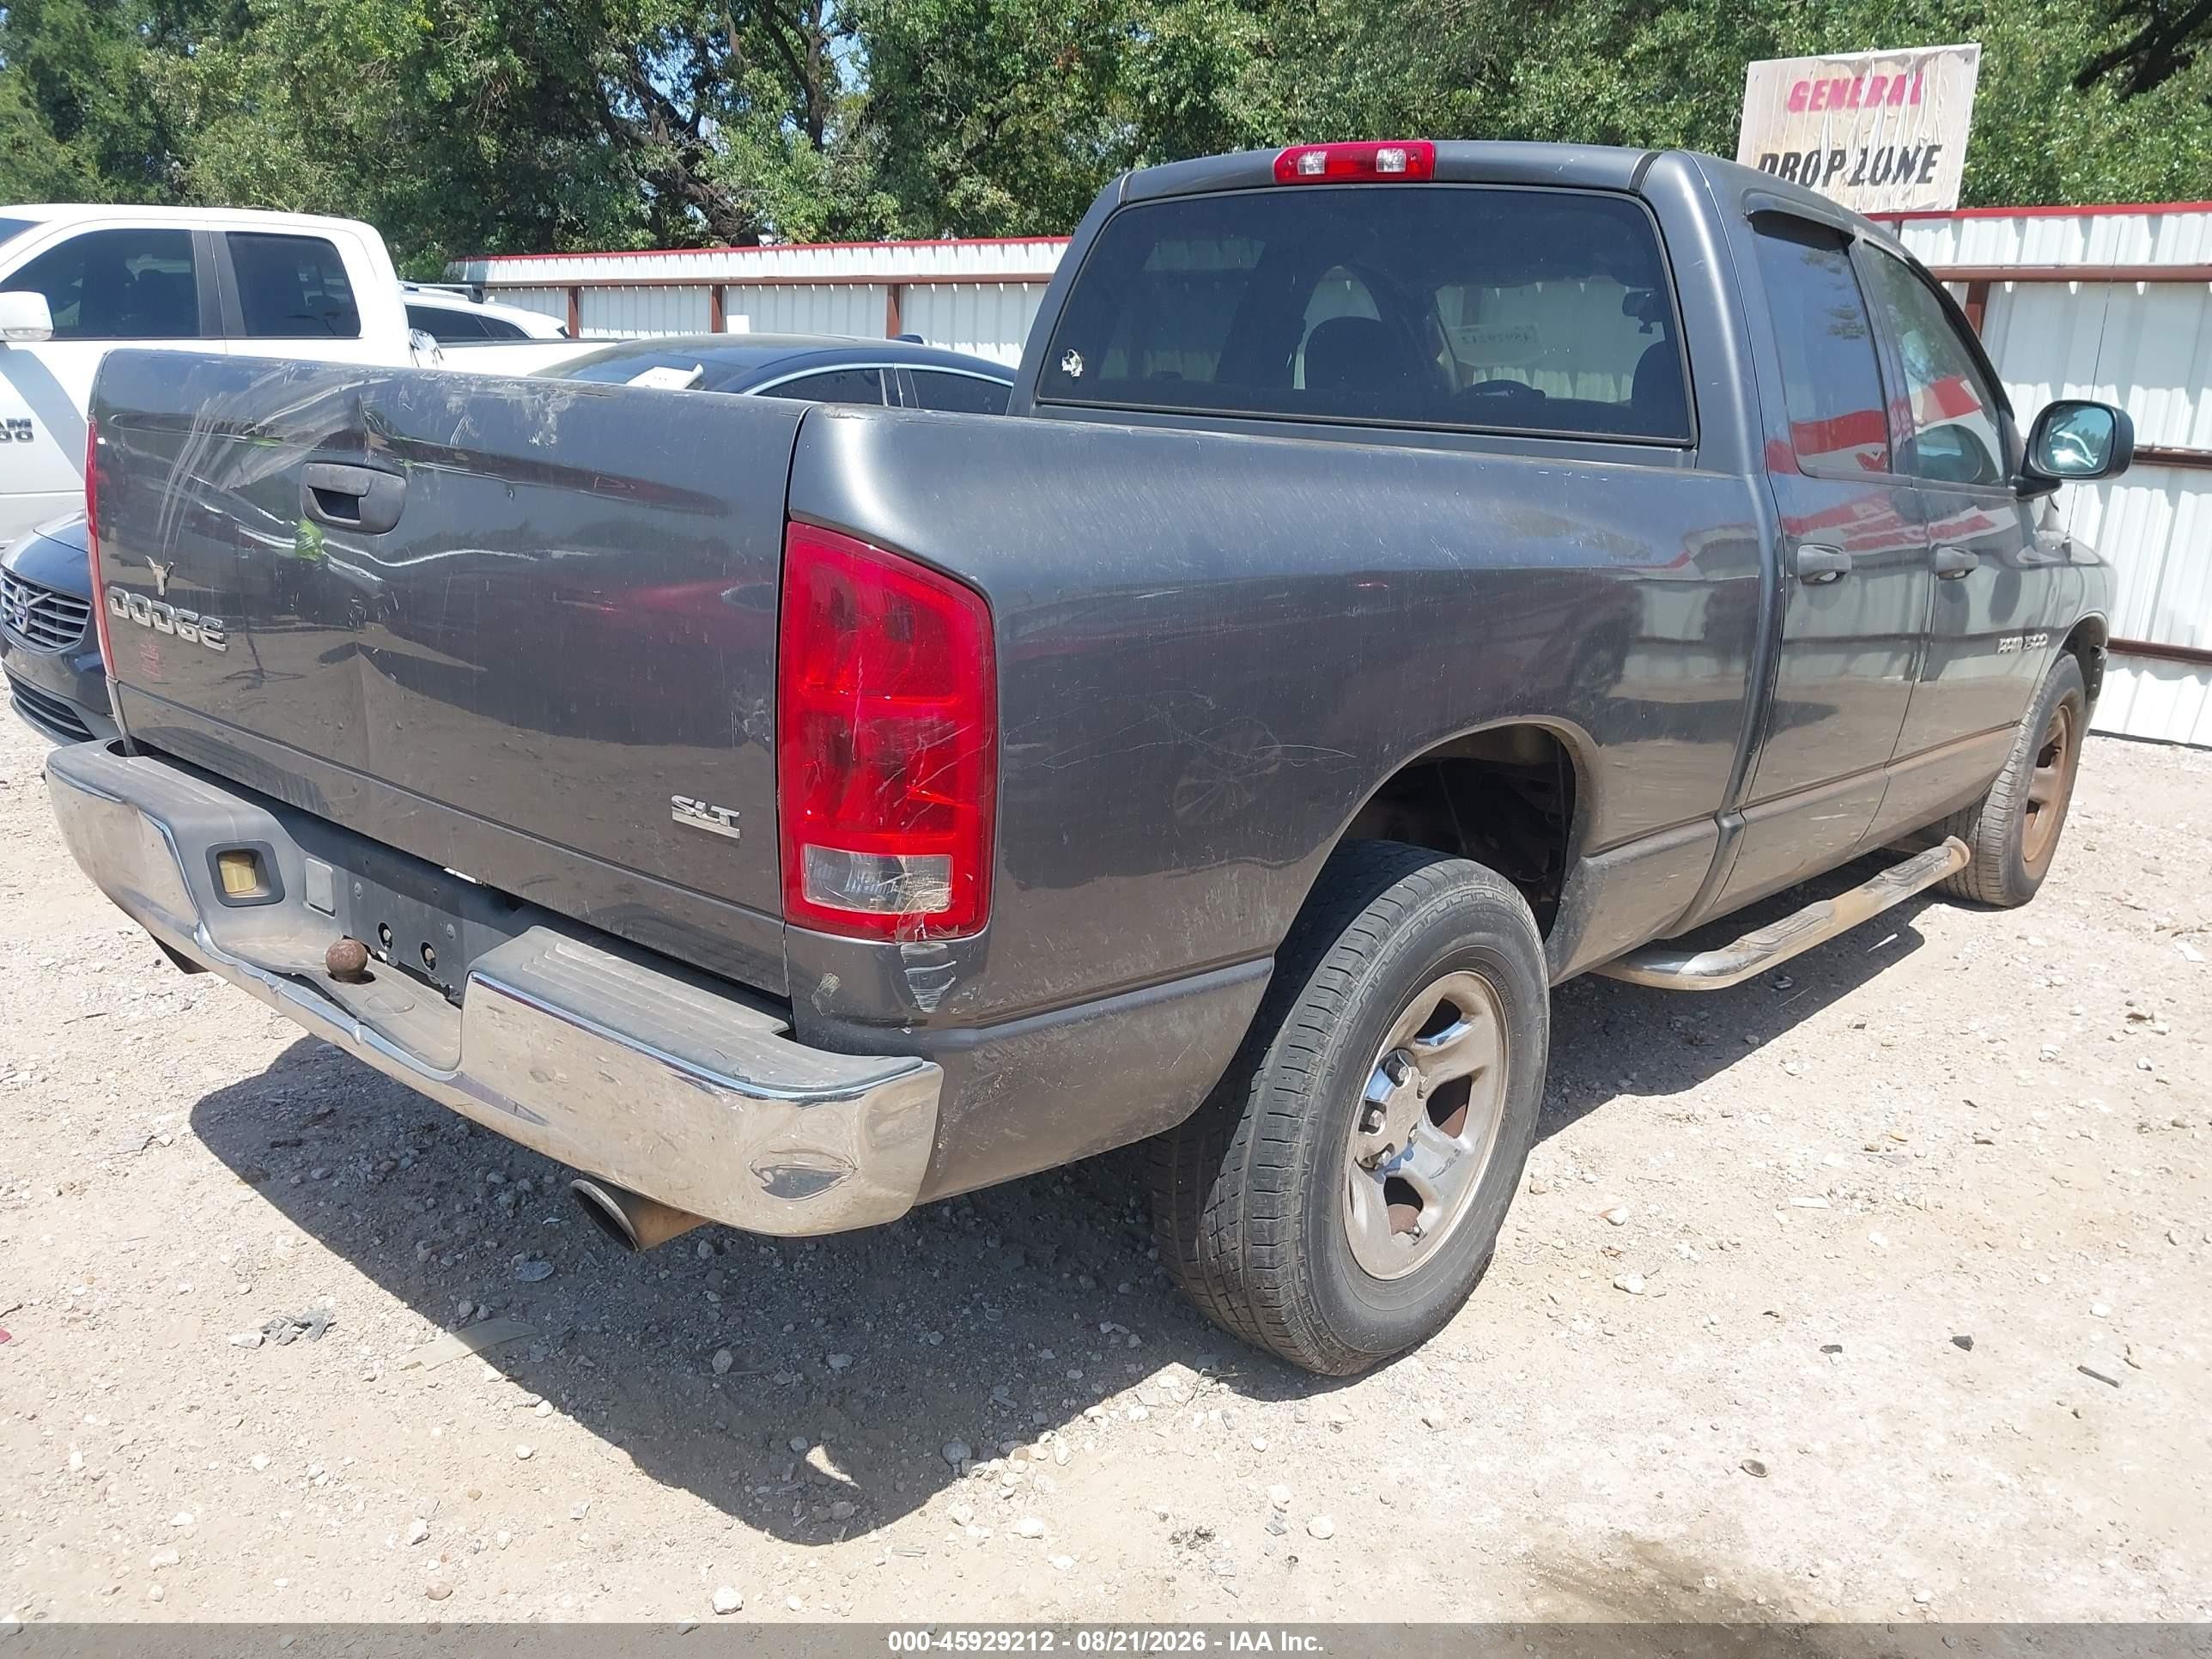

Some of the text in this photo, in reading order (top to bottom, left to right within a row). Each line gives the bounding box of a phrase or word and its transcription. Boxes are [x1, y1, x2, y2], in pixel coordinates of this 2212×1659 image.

[1788, 72, 1923, 113] GENERAL
[1759, 144, 1942, 187] DROP ZONE
[109, 586, 227, 653] DODGE
[672, 794, 740, 830] SLT
